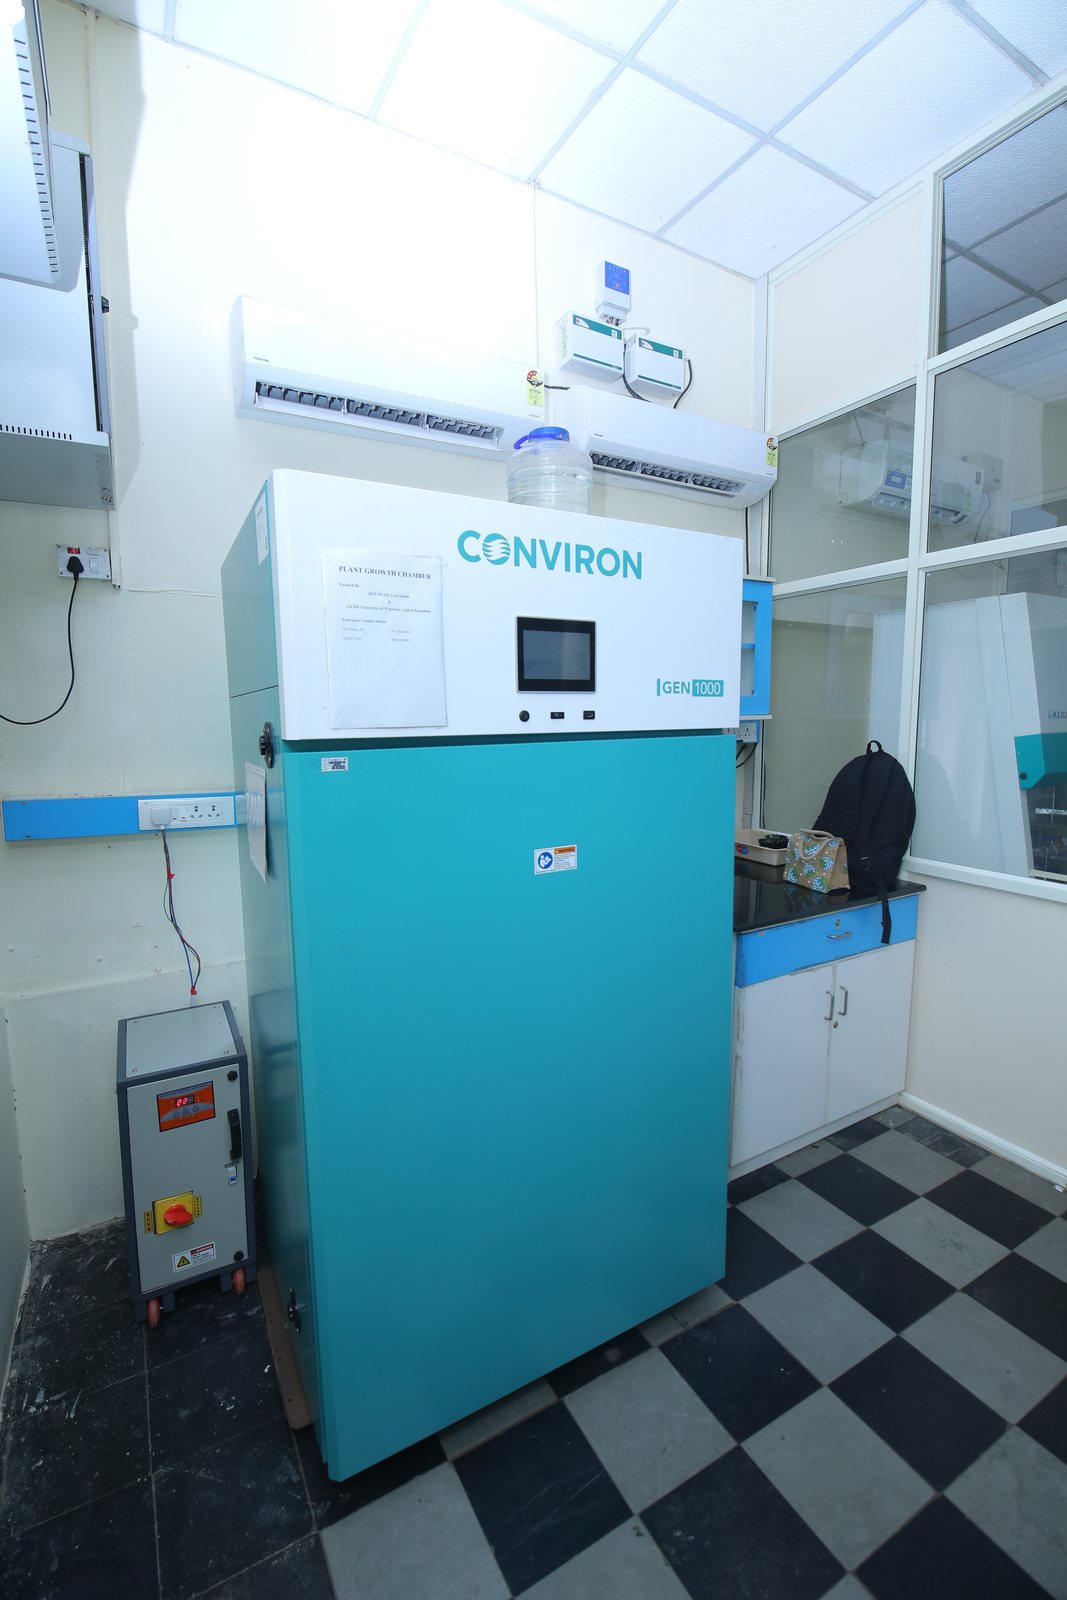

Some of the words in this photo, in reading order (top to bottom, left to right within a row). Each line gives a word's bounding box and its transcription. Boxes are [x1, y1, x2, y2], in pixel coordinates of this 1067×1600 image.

[457, 530, 642, 580] CONVIRON
[365, 568, 397, 577] GROWTH
[398, 571, 431, 579] CHAMBER
[694, 681, 721, 695] 1000
